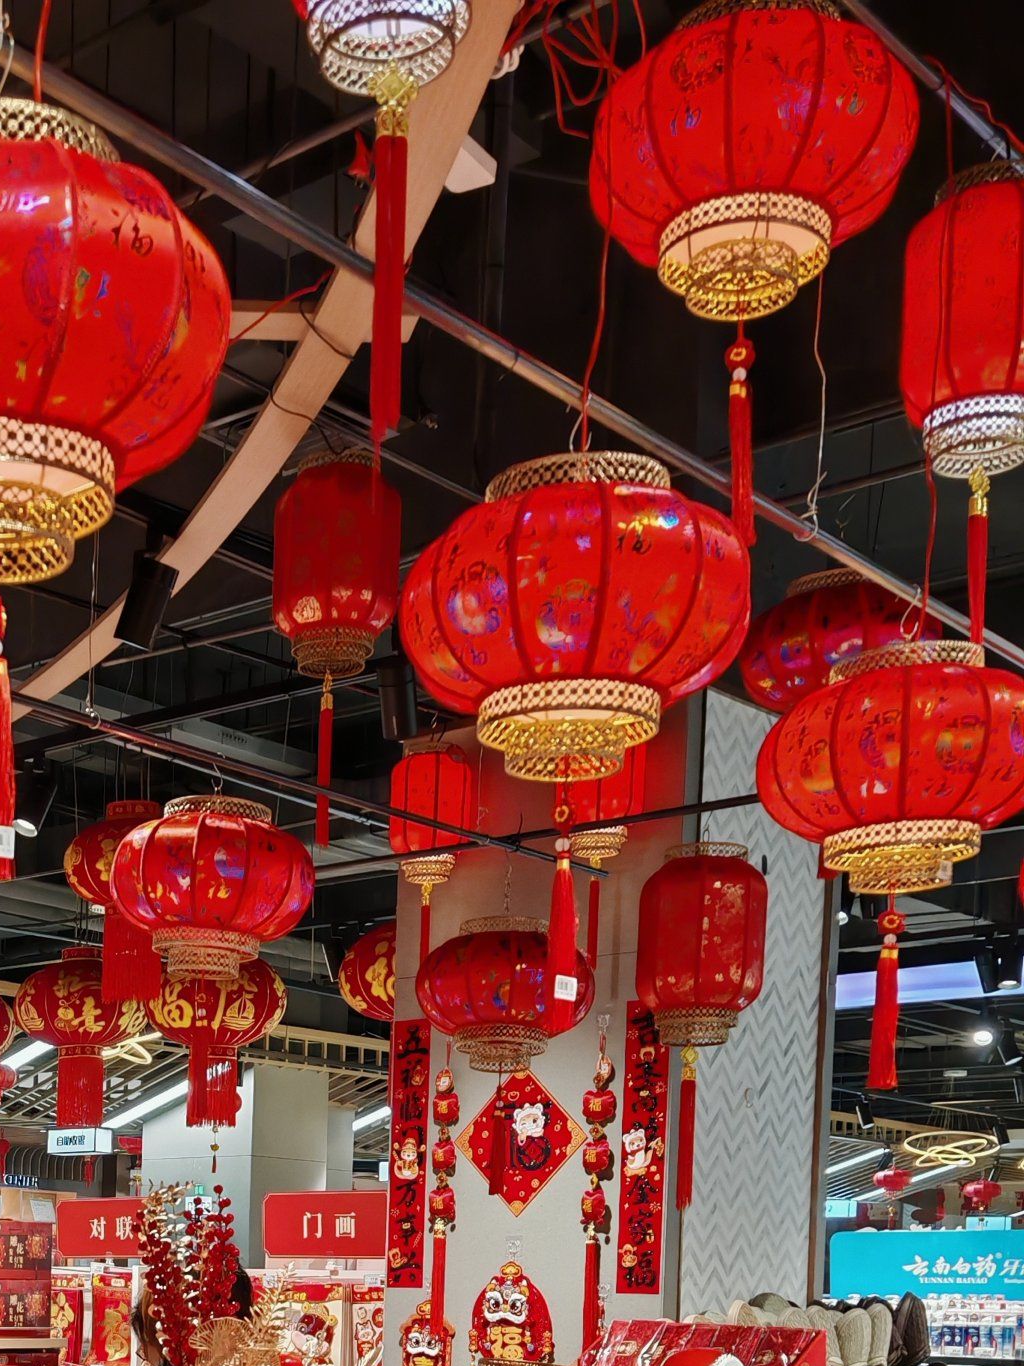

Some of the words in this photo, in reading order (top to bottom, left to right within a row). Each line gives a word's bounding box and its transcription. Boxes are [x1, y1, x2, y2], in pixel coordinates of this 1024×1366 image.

[589, 1098, 602, 1113] 福
[56, 1135, 86, 1147] 自助收银
[89, 1216, 134, 1242] 对联
[302, 1211, 356, 1240] 门画
[902, 1252, 997, 1278] 云南白药
[919, 1276, 955, 1285] YUNNAN
[955, 1276, 988, 1285] BAIYAO
[488, 1325, 525, 1361] 福
